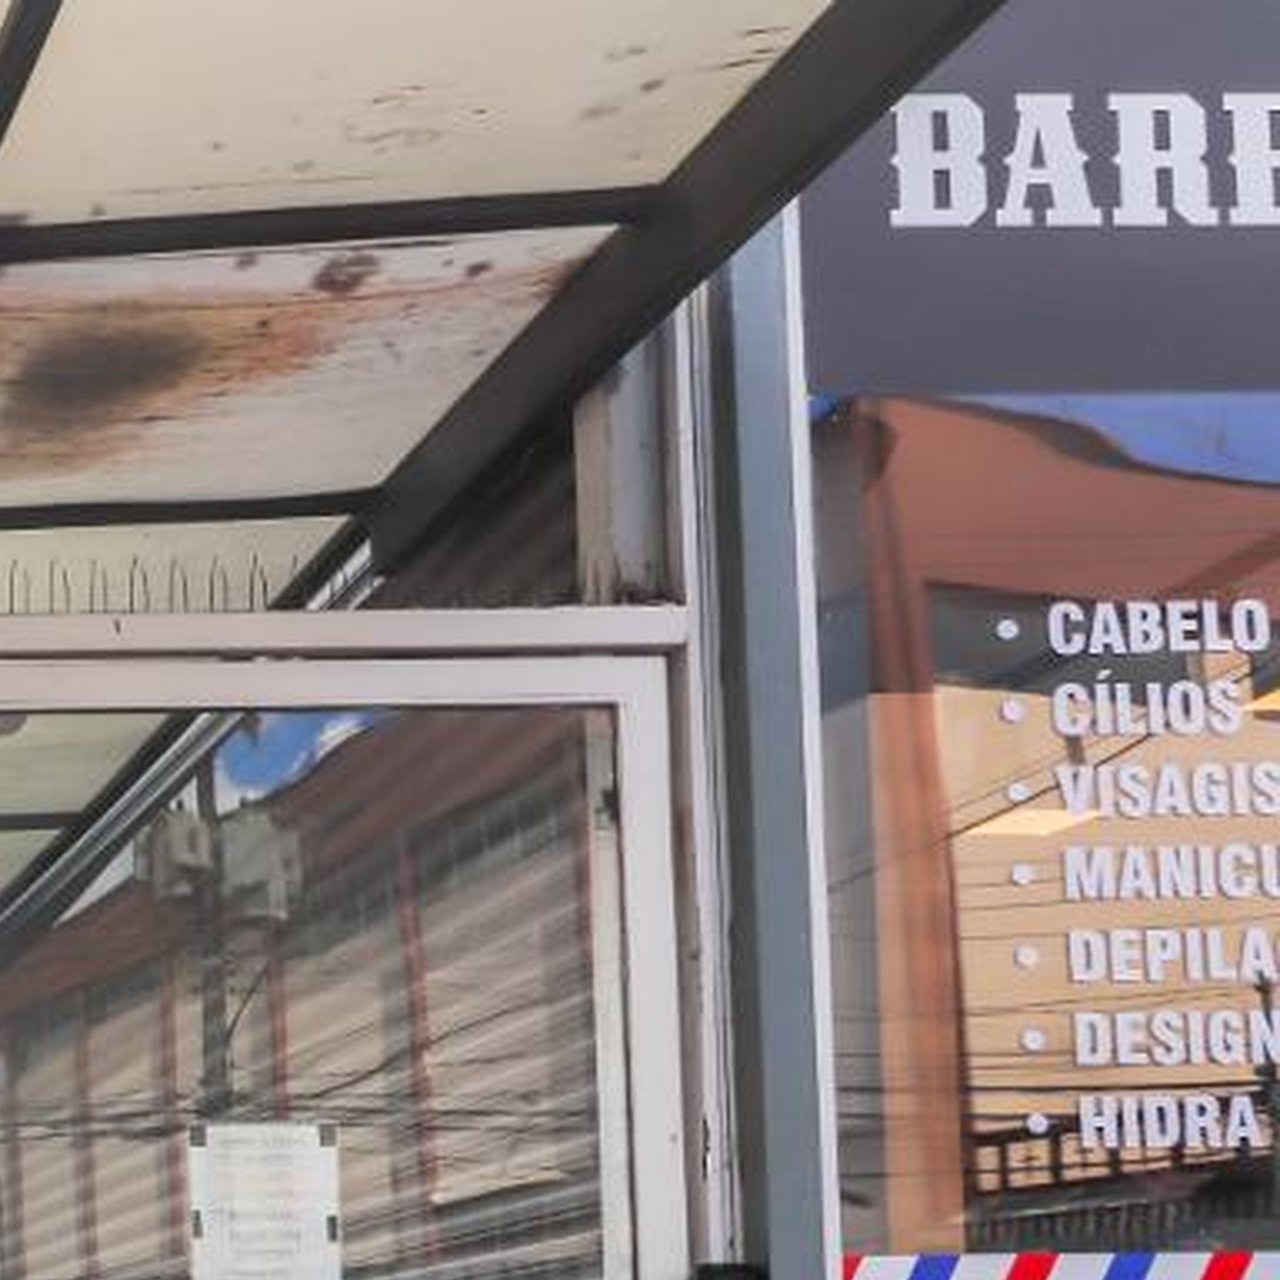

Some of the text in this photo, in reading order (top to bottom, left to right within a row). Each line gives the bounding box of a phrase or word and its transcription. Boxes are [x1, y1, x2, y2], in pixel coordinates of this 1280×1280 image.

[1047, 598, 1271, 655] CABELO
[1051, 668, 1243, 737] CÍLIOS
[1054, 761, 1280, 819] VISAGIS
[1072, 1010, 1280, 1067] DESIGN
[1079, 1094, 1263, 1150] HIDRA
